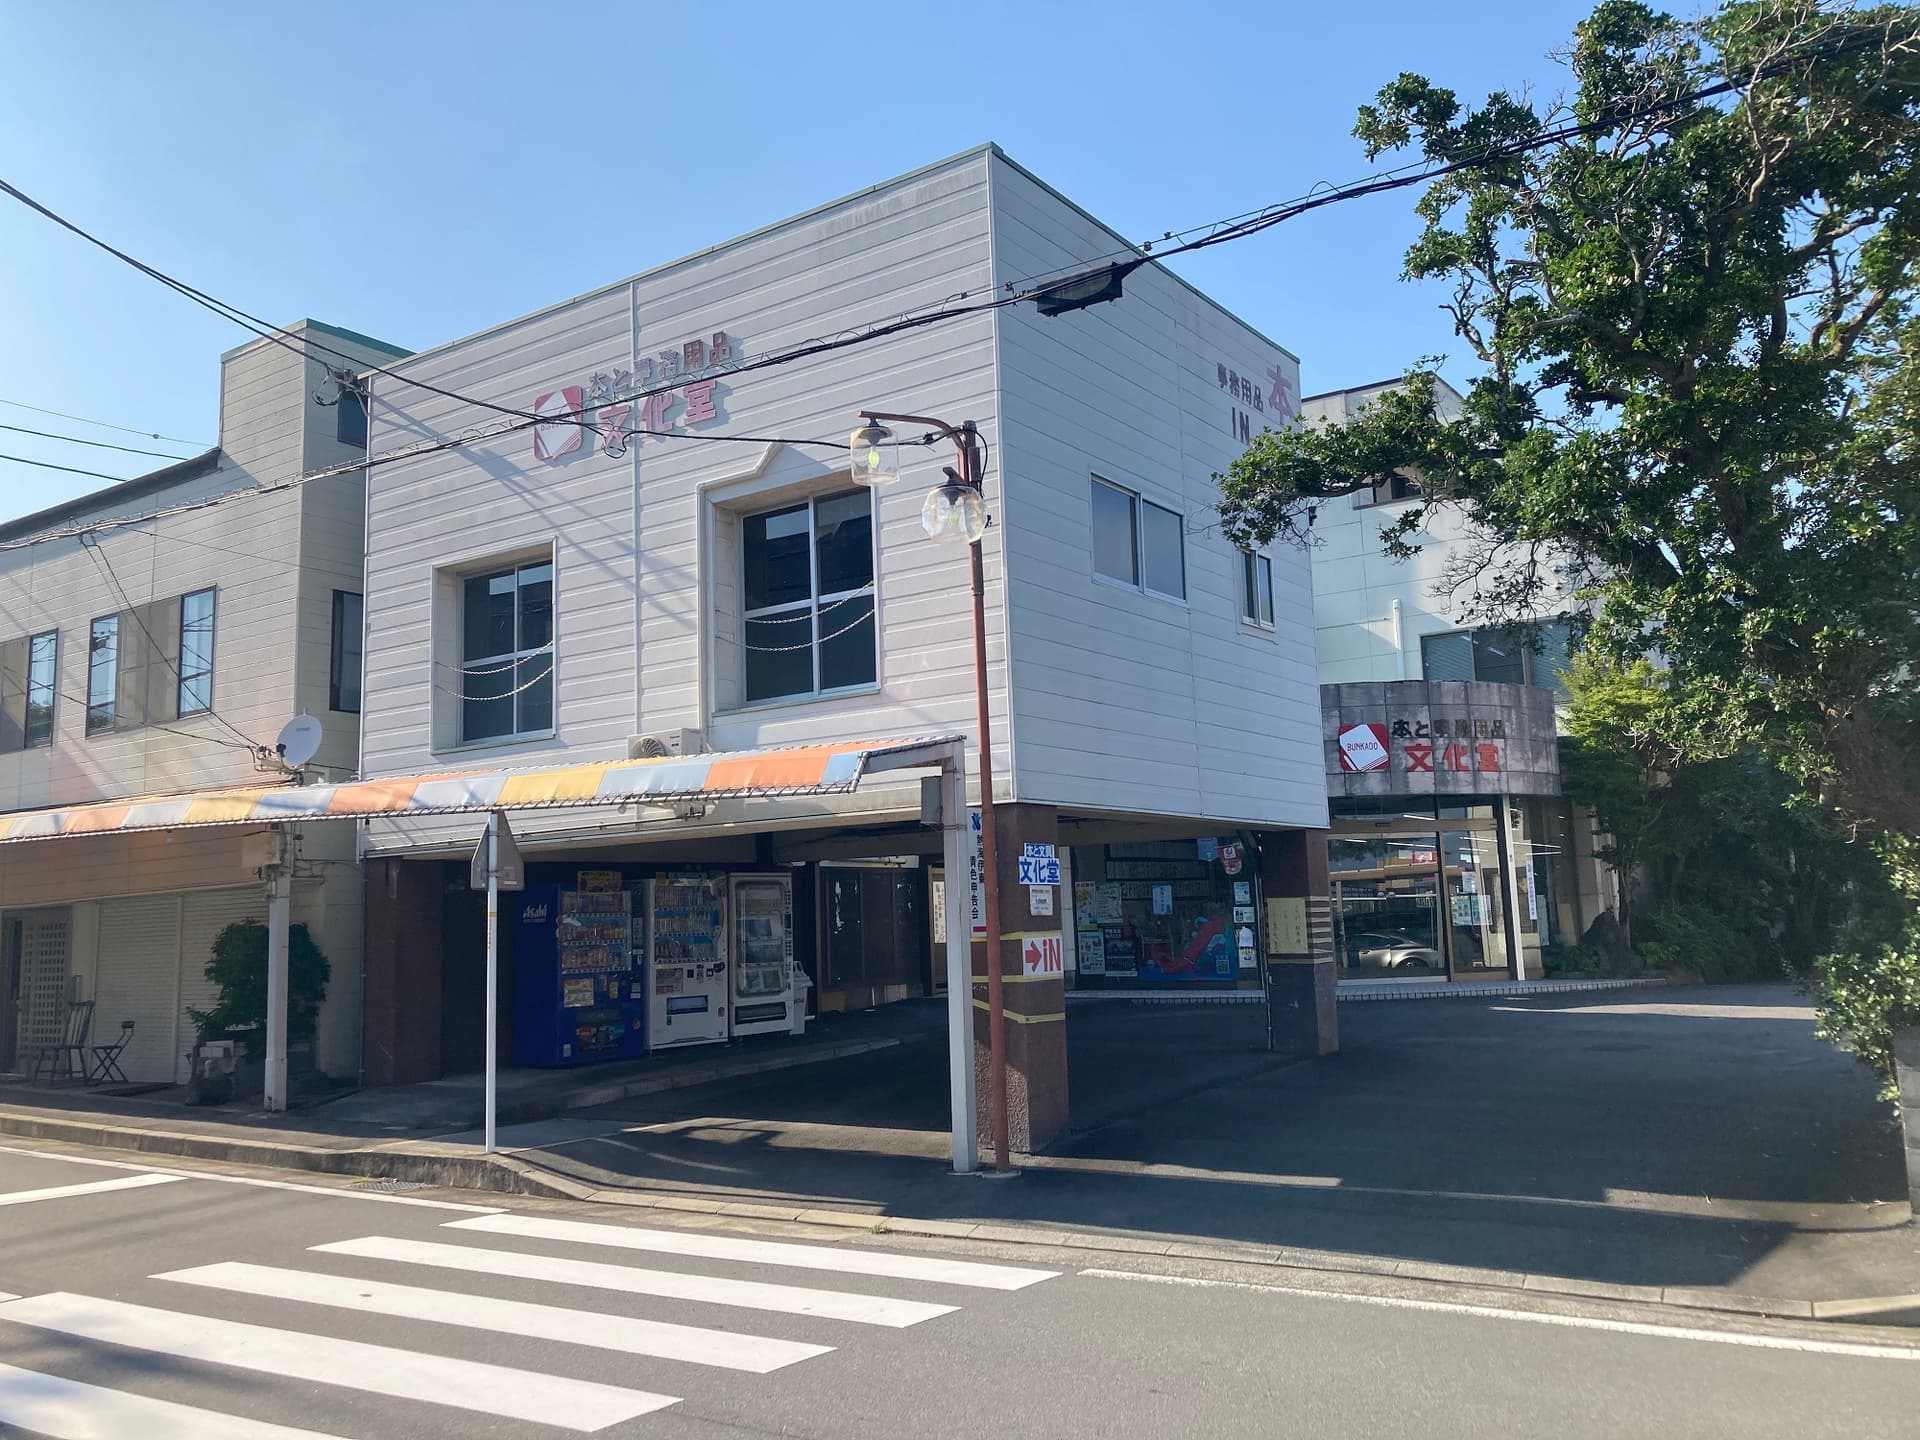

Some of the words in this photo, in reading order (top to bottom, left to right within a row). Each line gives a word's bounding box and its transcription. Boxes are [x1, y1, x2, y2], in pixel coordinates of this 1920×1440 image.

[1217, 361, 1264, 413] 事務用品
[1266, 363, 1295, 425] 本
[1231, 406, 1250, 446] IN
[1346, 741, 1378, 752] BUNKADO
[1404, 743, 1500, 772] 文化堂
[1020, 858, 1060, 883] 文化堂
[522, 904, 548, 919] Asahi
